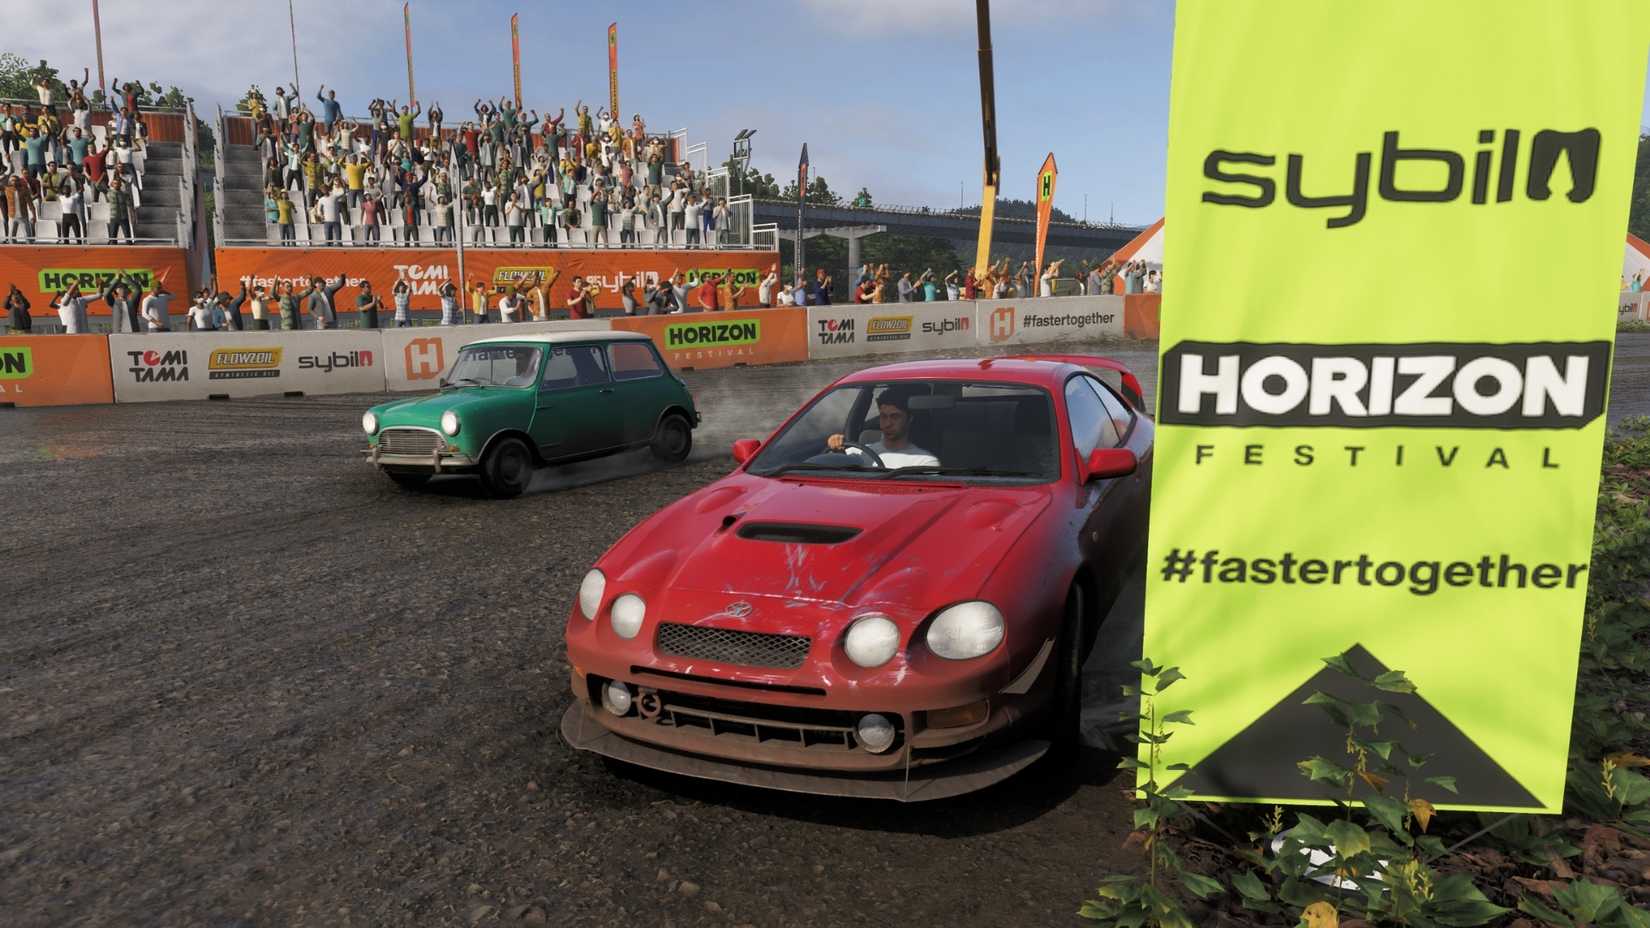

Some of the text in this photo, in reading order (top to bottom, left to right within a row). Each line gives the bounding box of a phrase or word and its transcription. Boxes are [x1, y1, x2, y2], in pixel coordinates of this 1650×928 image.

[1202, 127, 1521, 229] sybil
[818, 318, 855, 332] TOMI
[922, 318, 960, 336] sybil
[1023, 311, 1115, 328] #fastertogether
[669, 323, 756, 345] HORIZON
[818, 332, 855, 345] TAMA
[127, 350, 188, 366] TOMI
[298, 351, 359, 373] sybil
[129, 366, 189, 383] TAMA
[1178, 353, 1590, 417] HORIZON
[1195, 444, 1560, 469] FESTIVAL
[1160, 548, 1588, 596] #fastertogether
